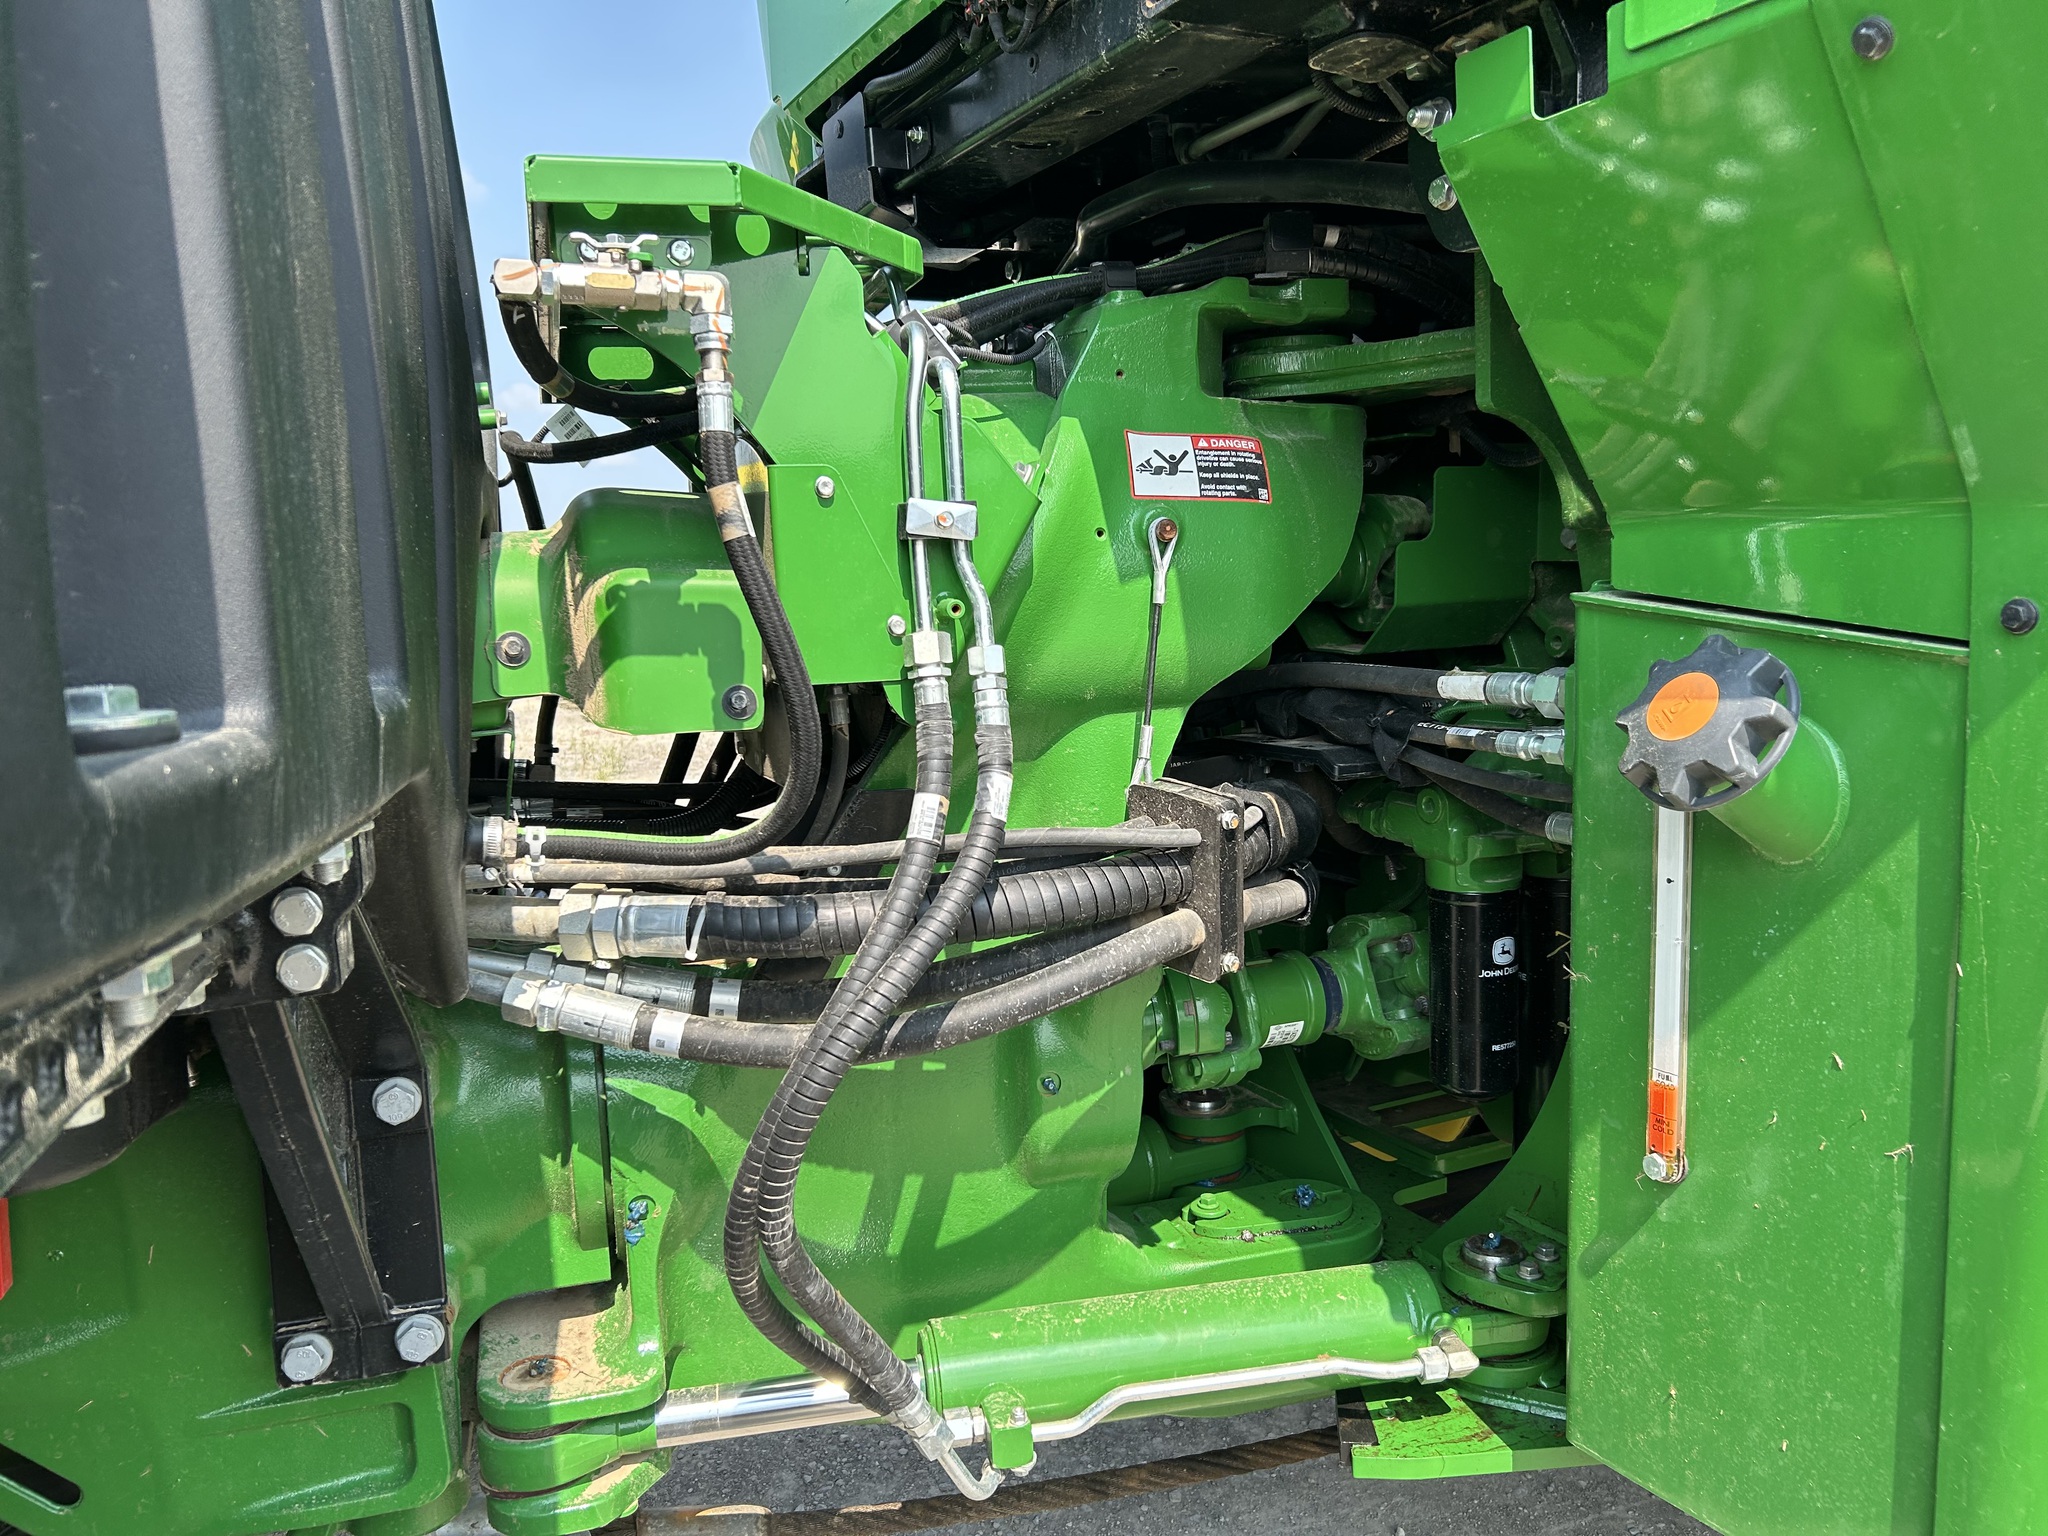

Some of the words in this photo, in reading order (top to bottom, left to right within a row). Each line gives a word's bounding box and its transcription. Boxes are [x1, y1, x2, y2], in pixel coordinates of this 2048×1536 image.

[1210, 439, 1255, 450] DANGER
[1237, 451, 1256, 459] rotating
[1478, 970, 1503, 978] JOHN
[1655, 1117, 1670, 1127] MIN
[1652, 1125, 1675, 1136] COLD
